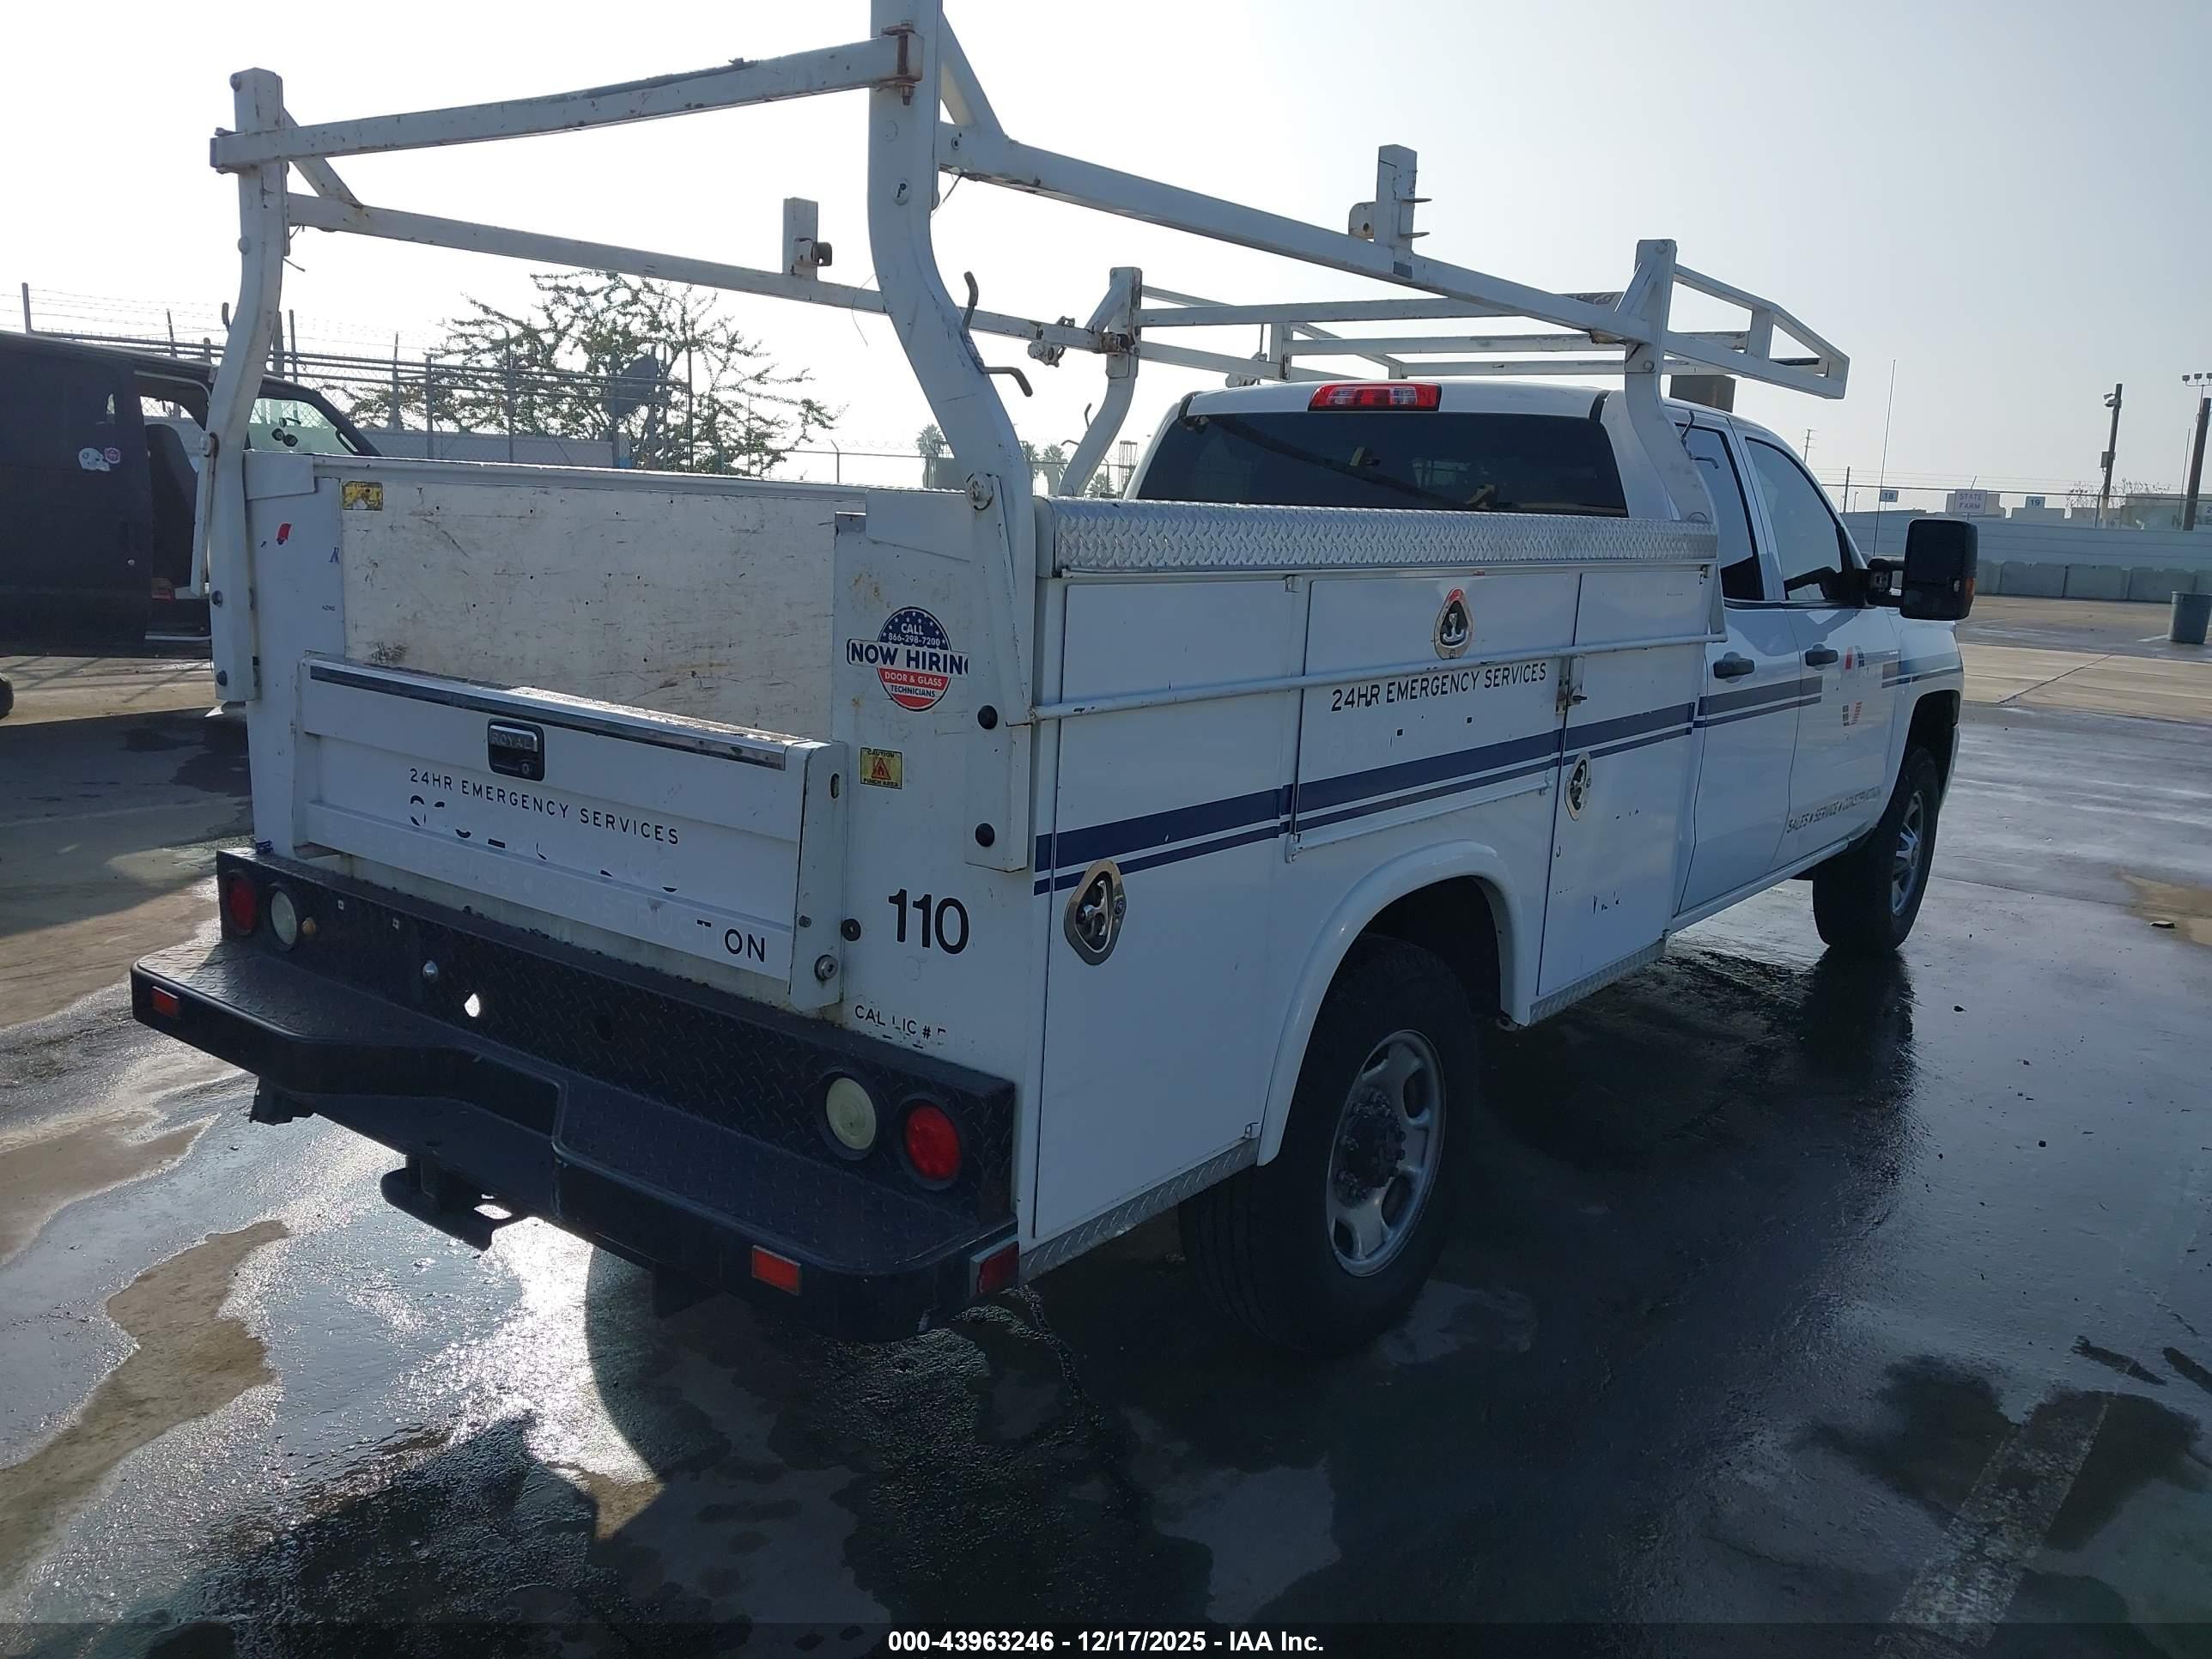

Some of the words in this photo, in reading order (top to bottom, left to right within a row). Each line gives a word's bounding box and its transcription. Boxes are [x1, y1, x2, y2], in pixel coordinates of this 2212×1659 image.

[901, 623, 924, 635] CALL
[888, 632, 941, 647] 866-298-7200
[851, 641, 899, 665] NOW
[884, 672, 908, 684] DOOR
[909, 675, 915, 684] &
[917, 676, 942, 687] GLASS
[1331, 684, 1380, 712] 24HR
[1386, 671, 1480, 703] EMERGENCY
[1484, 662, 1547, 689] SERVICES
[890, 684, 936, 698] TECHNICIANS
[867, 750, 895, 758] CAUTION
[863, 777, 882, 786] PINCH
[410, 768, 453, 791] 24HR
[461, 780, 569, 819] EMERGENCY
[580, 808, 679, 845] SERVICES
[888, 888, 969, 955] 110
[854, 1005, 886, 1026] CAL
